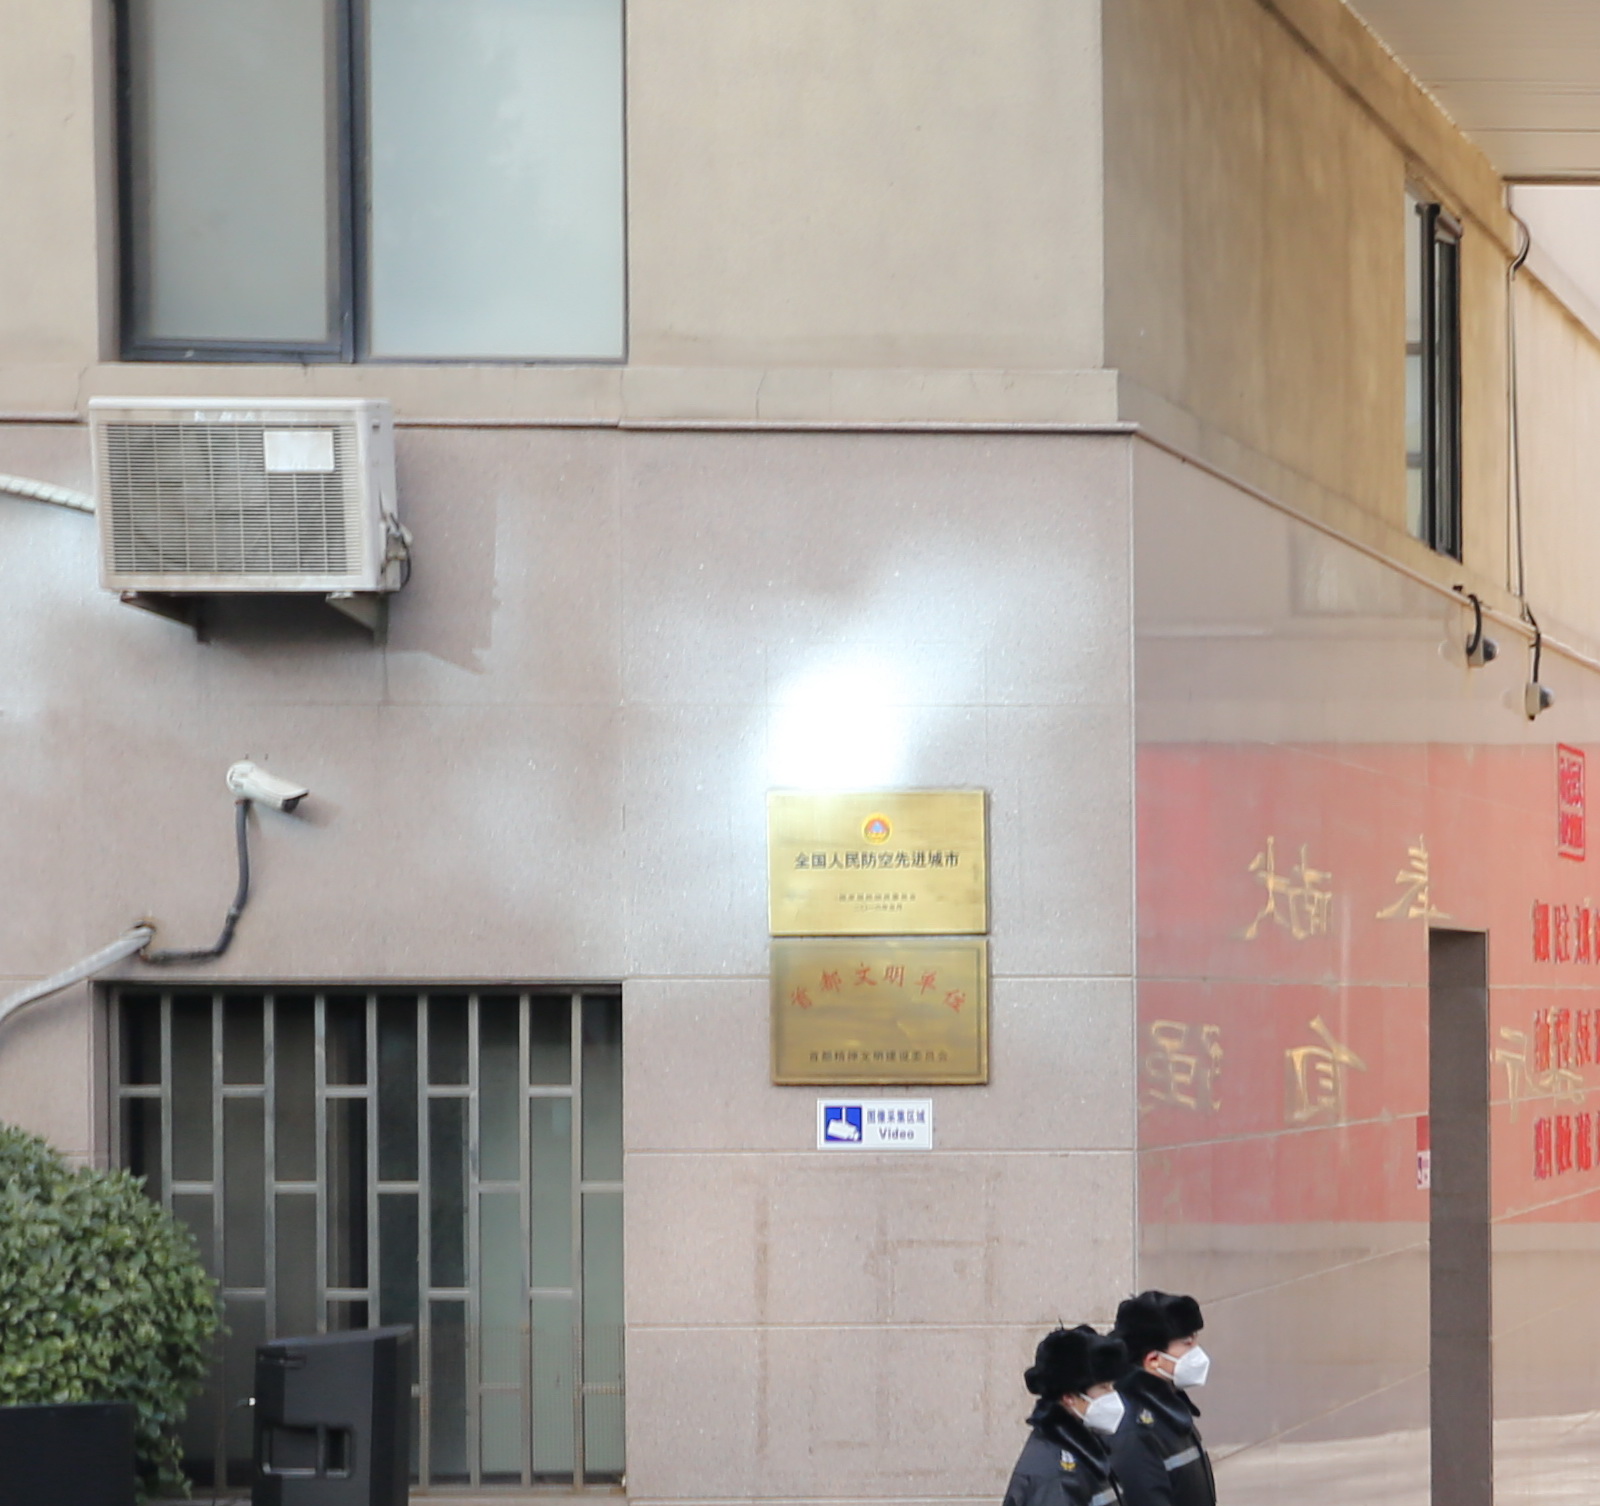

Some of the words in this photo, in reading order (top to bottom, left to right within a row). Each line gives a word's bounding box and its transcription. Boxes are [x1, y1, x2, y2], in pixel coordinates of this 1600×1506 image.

[795, 850, 959, 869] 全国人民防空先进城市
[867, 1109, 927, 1125] 图像采集区域
[879, 1127, 916, 1140] Video
